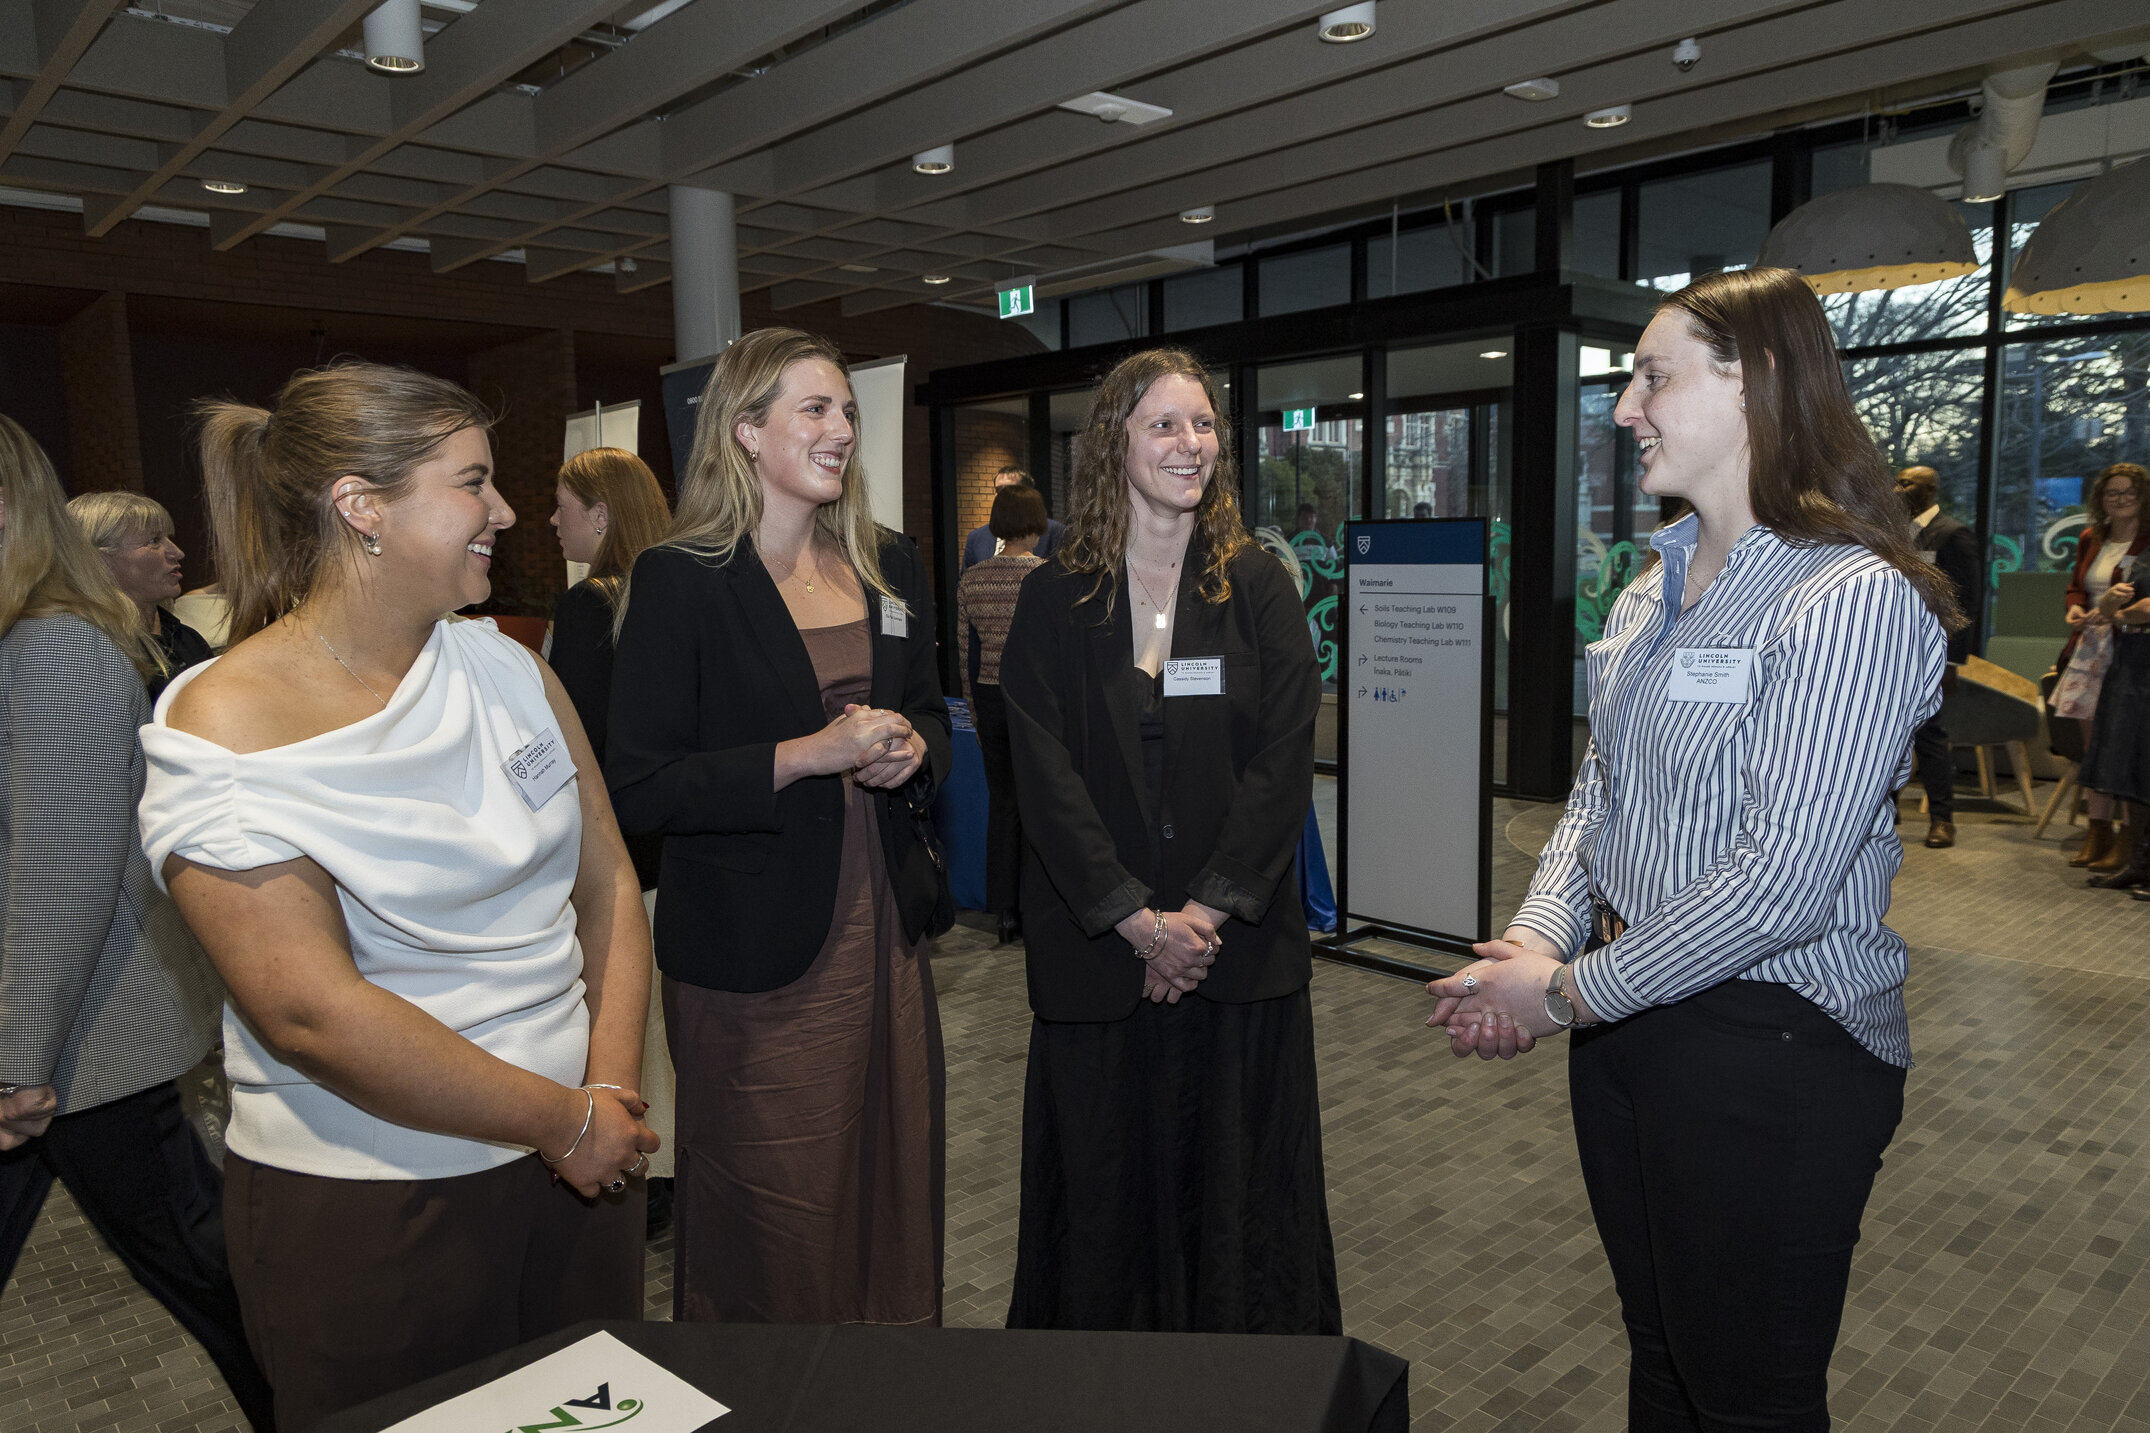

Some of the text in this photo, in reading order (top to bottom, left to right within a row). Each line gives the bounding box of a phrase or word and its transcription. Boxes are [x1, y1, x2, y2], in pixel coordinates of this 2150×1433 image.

[1359, 578, 1393, 587] Waimarie
[1374, 604, 1457, 615] Soils Teaching Lab W109
[1374, 620, 1465, 630] Biology Teaching Lab W110
[1374, 635, 1472, 647] Chemistry Teaching Lab W111
[1373, 654, 1423, 664] Lecture Rooms
[1686, 670, 1713, 678] Stephanie
[523, 742, 544, 762] LINCOLN
[526, 739, 555, 767] UNIVERSITY
[532, 769, 545, 781] Hannah
